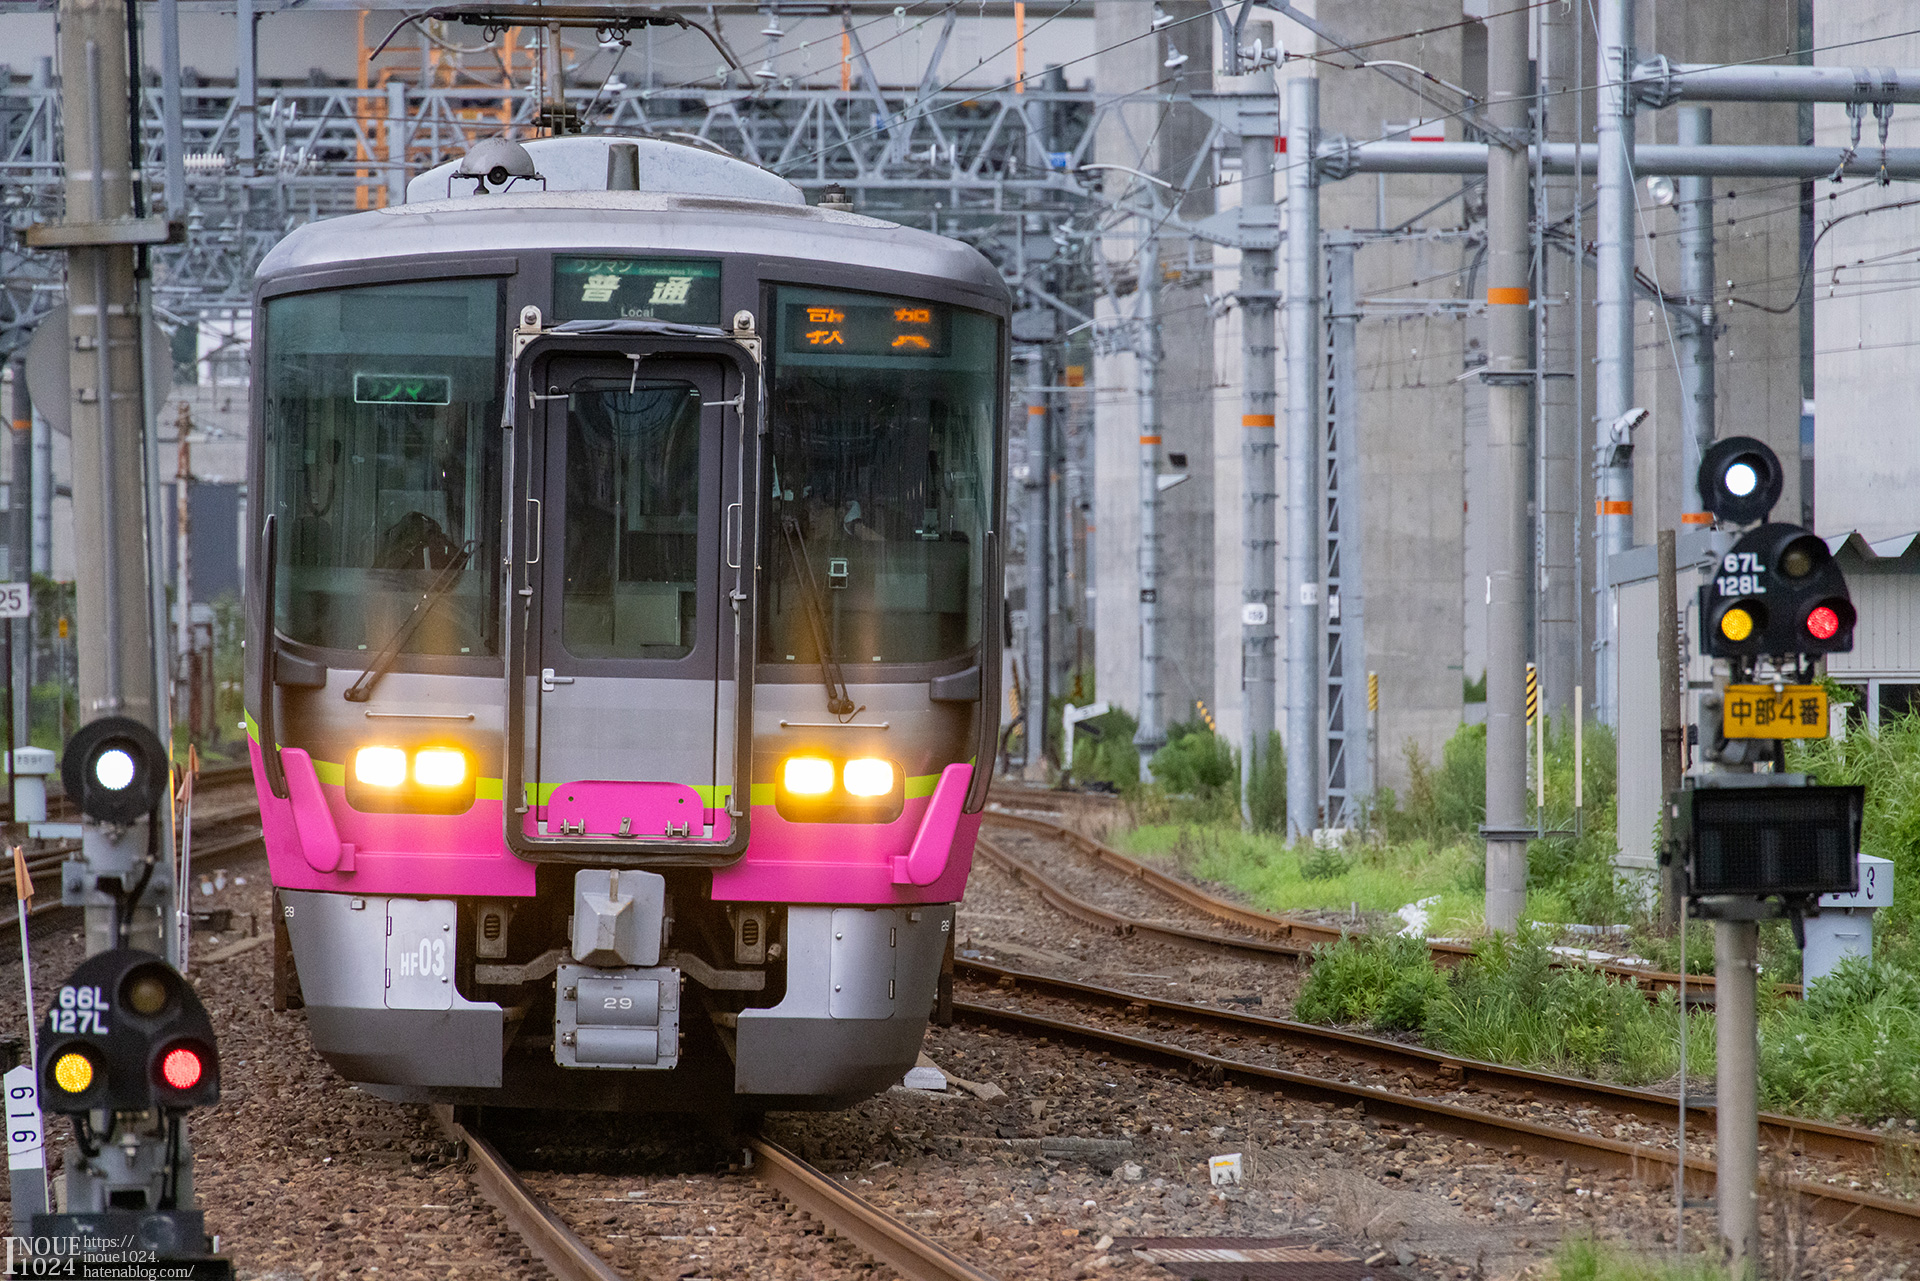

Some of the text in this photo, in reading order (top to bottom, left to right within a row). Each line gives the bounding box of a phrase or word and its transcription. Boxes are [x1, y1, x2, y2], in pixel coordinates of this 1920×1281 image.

[581, 274, 693, 305] 普通
[620, 306, 654, 318] Local
[1724, 552, 1766, 573] 67L
[1717, 574, 1767, 597] 128L
[1731, 697, 1820, 726] 中部4番
[284, 906, 295, 917] 29
[400, 938, 446, 976] HF03
[59, 985, 110, 1011] 66L
[603, 997, 632, 1010] 29
[49, 1009, 109, 1034] 127L
[10, 1087, 36, 1143] 616
